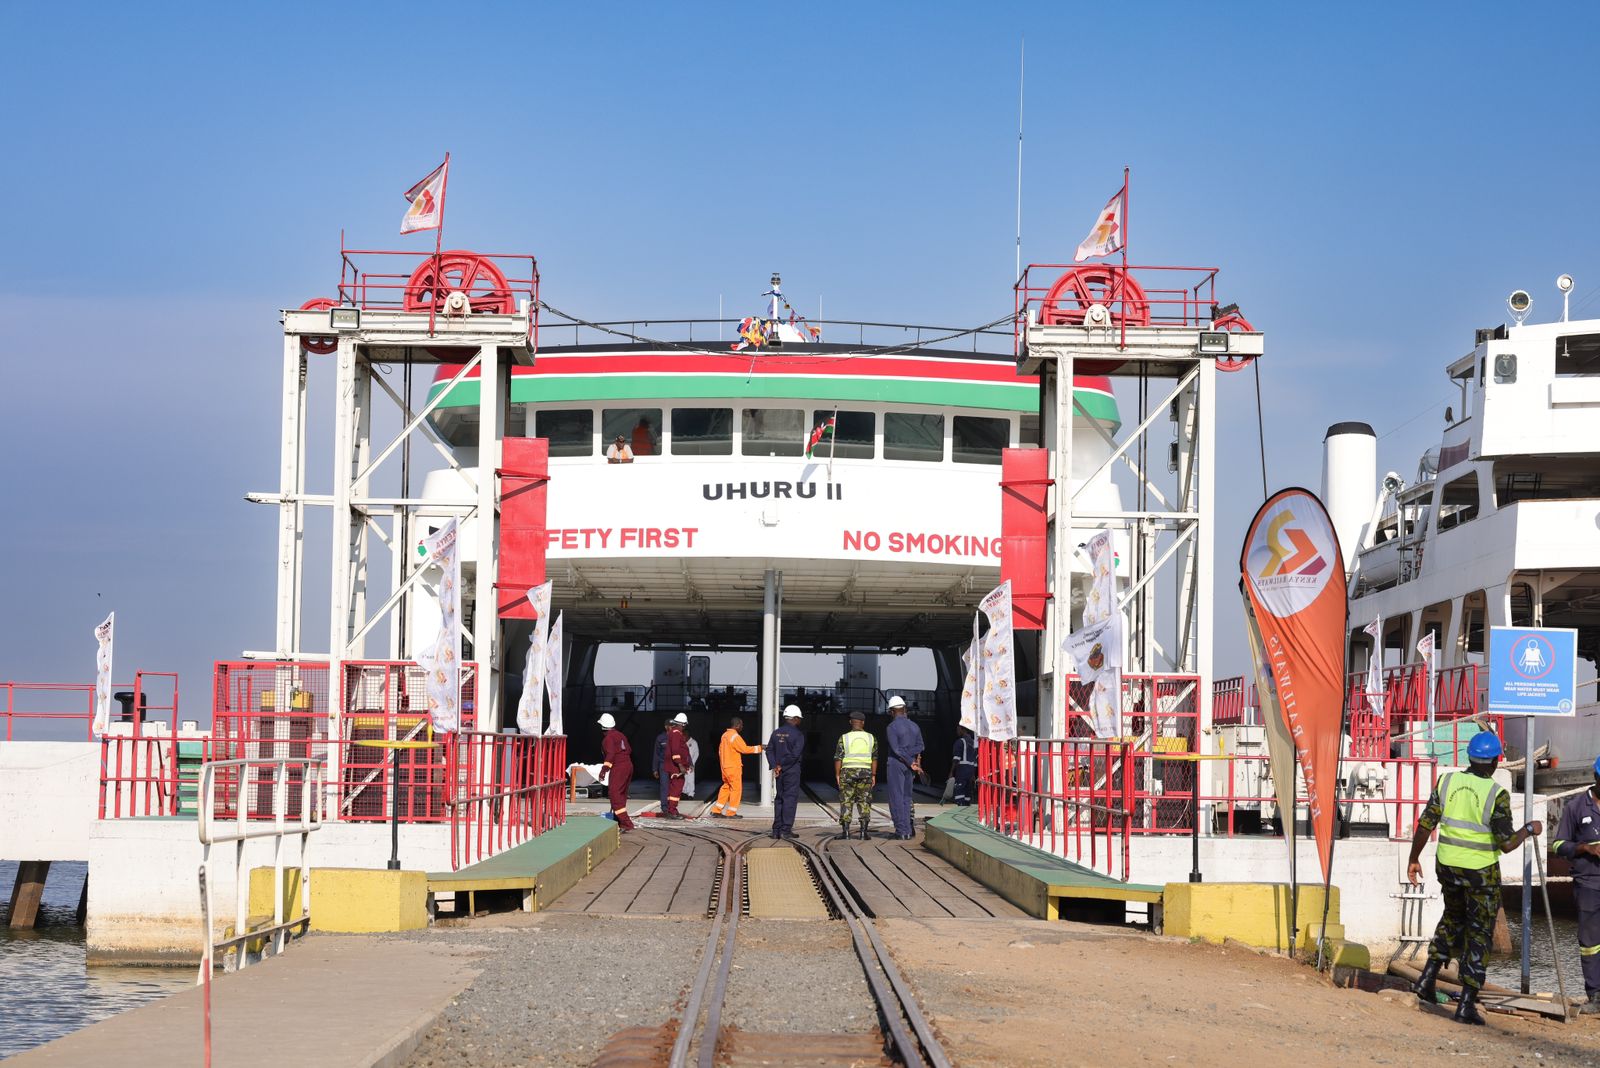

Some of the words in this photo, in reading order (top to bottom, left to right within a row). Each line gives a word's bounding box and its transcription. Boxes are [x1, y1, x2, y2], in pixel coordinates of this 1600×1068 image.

[703, 481, 816, 501] UHURU
[827, 483, 842, 500] II
[545, 528, 613, 550] FETY
[620, 528, 699, 549] FIRST
[843, 530, 881, 552] NO
[888, 532, 1001, 558] SMOKING
